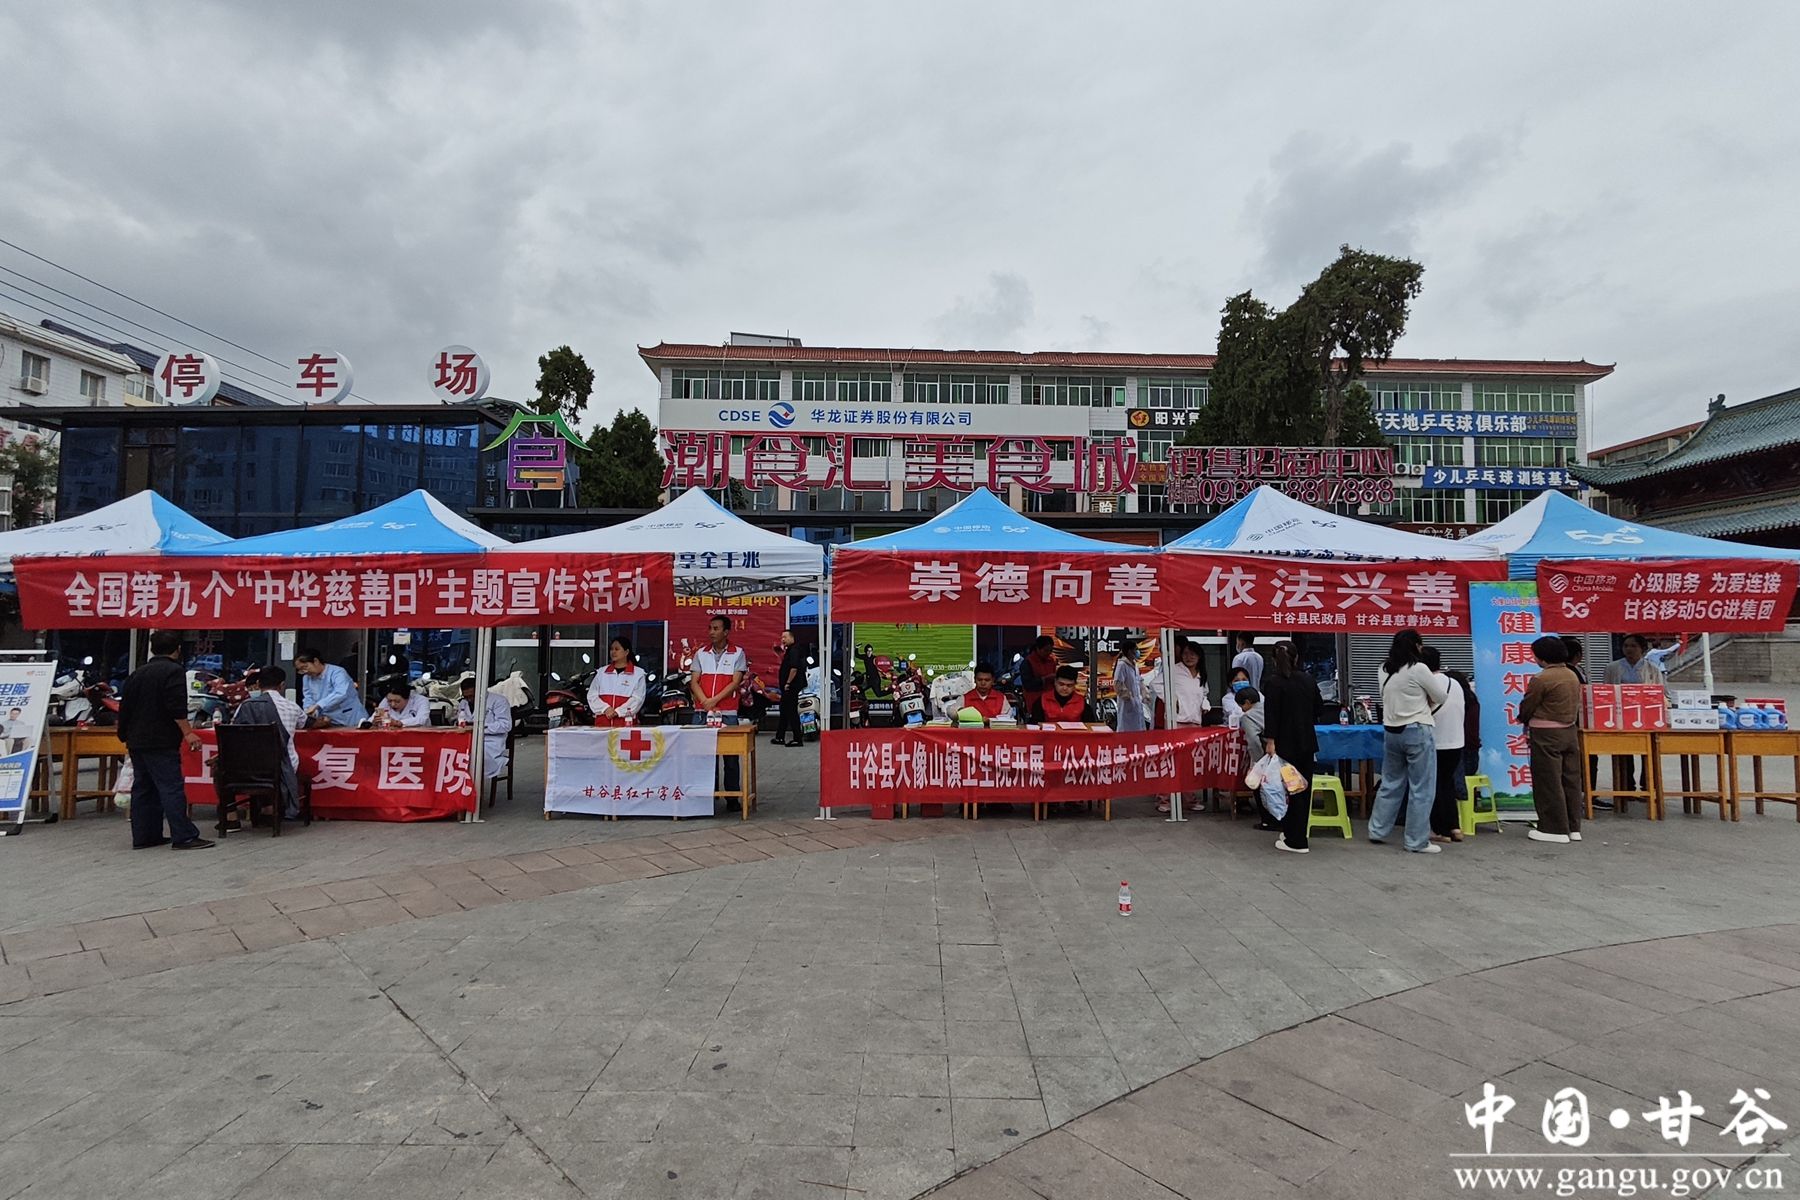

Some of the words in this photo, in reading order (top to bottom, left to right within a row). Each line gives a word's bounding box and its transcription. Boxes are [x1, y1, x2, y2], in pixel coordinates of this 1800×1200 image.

[719, 410, 760, 422] CDSE
[810, 408, 972, 426] 华龙证券股份有限公司
[660, 430, 1137, 493] 潮食汇美食城
[1167, 447, 1394, 477] 销售招商中心
[1200, 478, 1394, 504] 0938817888
[908, 561, 1160, 606] 崇德向善
[1202, 566, 1460, 613] 依法兴善
[1572, 575, 1617, 585] 中国移动
[1628, 572, 1700, 594] 心级服务
[1708, 572, 1782, 594] 为爱连接
[64, 567, 651, 619] 全国第九个“中华慈善日”主题宣传活动
[1355, 613, 1460, 628] 甘谷县慈善协会宣
[1624, 599, 1776, 621] 甘谷移动5G进集团
[583, 785, 685, 801] 甘谷县红十字会
